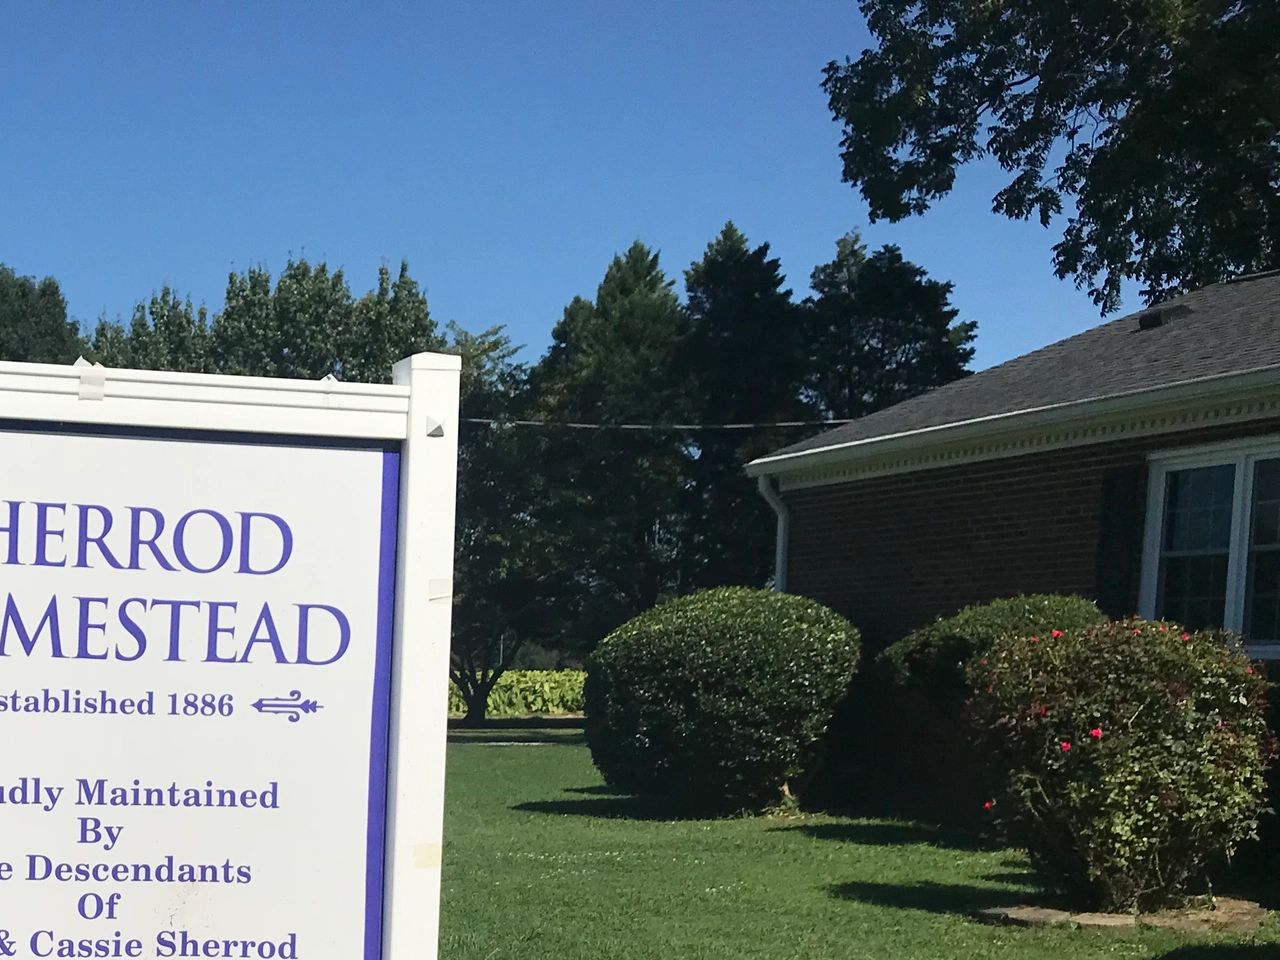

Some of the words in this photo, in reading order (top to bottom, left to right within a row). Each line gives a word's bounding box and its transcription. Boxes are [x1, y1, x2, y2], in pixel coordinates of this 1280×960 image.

[167, 692, 234, 718] 1886
[76, 778, 280, 809] Maintained
[77, 817, 124, 850] By
[26, 855, 253, 884] Descendants
[77, 893, 121, 921] Of
[30, 931, 143, 959] Cassie
[156, 932, 299, 960] Sherrod
